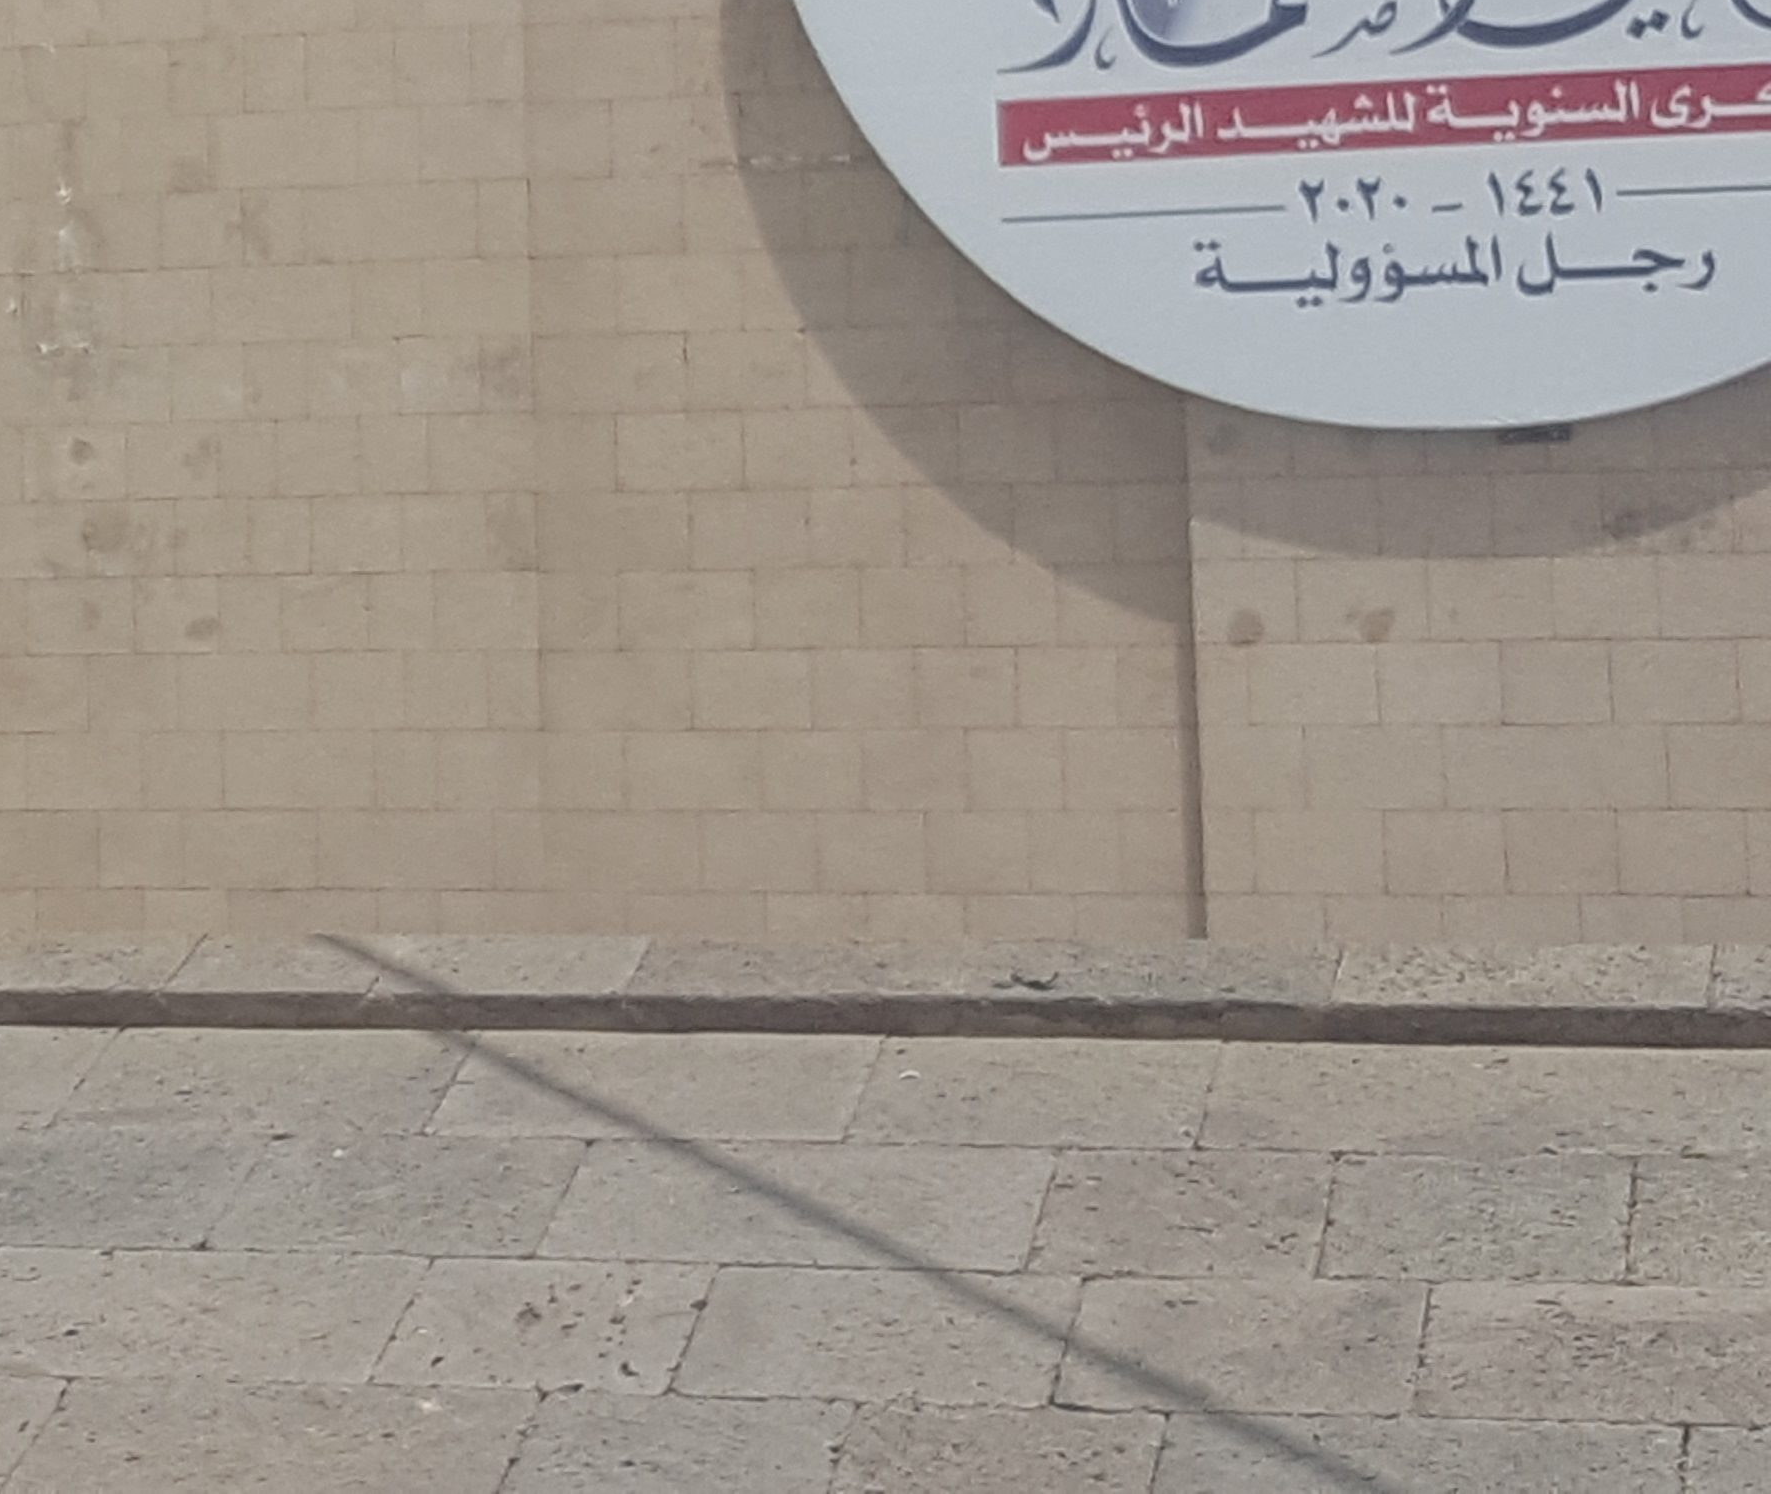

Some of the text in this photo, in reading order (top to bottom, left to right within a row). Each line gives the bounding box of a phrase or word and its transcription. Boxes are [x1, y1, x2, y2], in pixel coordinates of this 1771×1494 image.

[1021, 104, 1205, 161] الرئيس
[1215, 90, 1417, 152] للشهيد
[1425, 78, 1641, 144] السنوية
[1297, 175, 1409, 223] ٢٠٢٠
[1486, 166, 1604, 217] ١٤٤١
[1193, 232, 1716, 308] رجل المسؤولية
